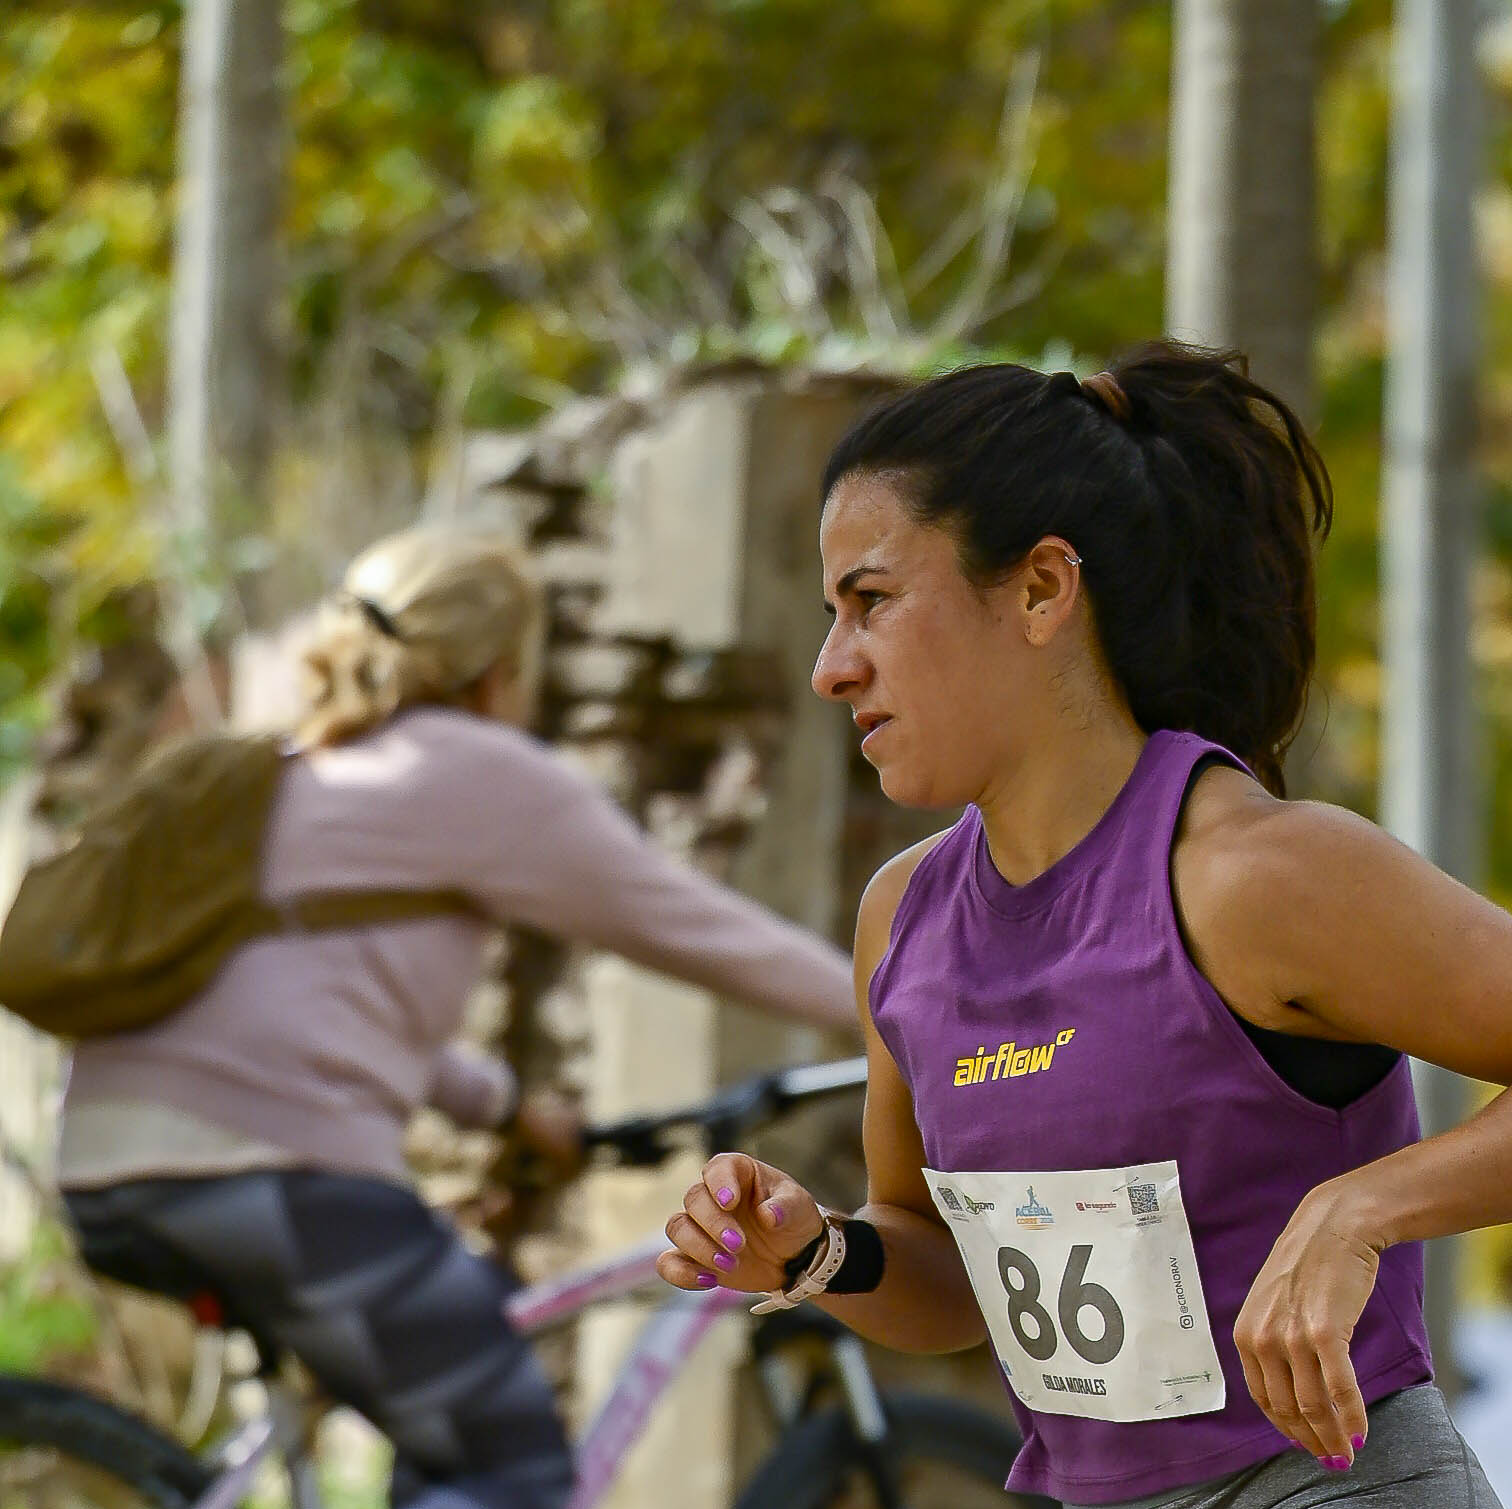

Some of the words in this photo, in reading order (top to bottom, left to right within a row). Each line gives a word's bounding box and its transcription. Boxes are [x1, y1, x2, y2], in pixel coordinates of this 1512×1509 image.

[953, 1041, 1056, 1087] airflow
[997, 1244, 1125, 1365] 86
[1042, 1373, 1068, 1392] GILDA
[1065, 1376, 1107, 1396] MORALES
